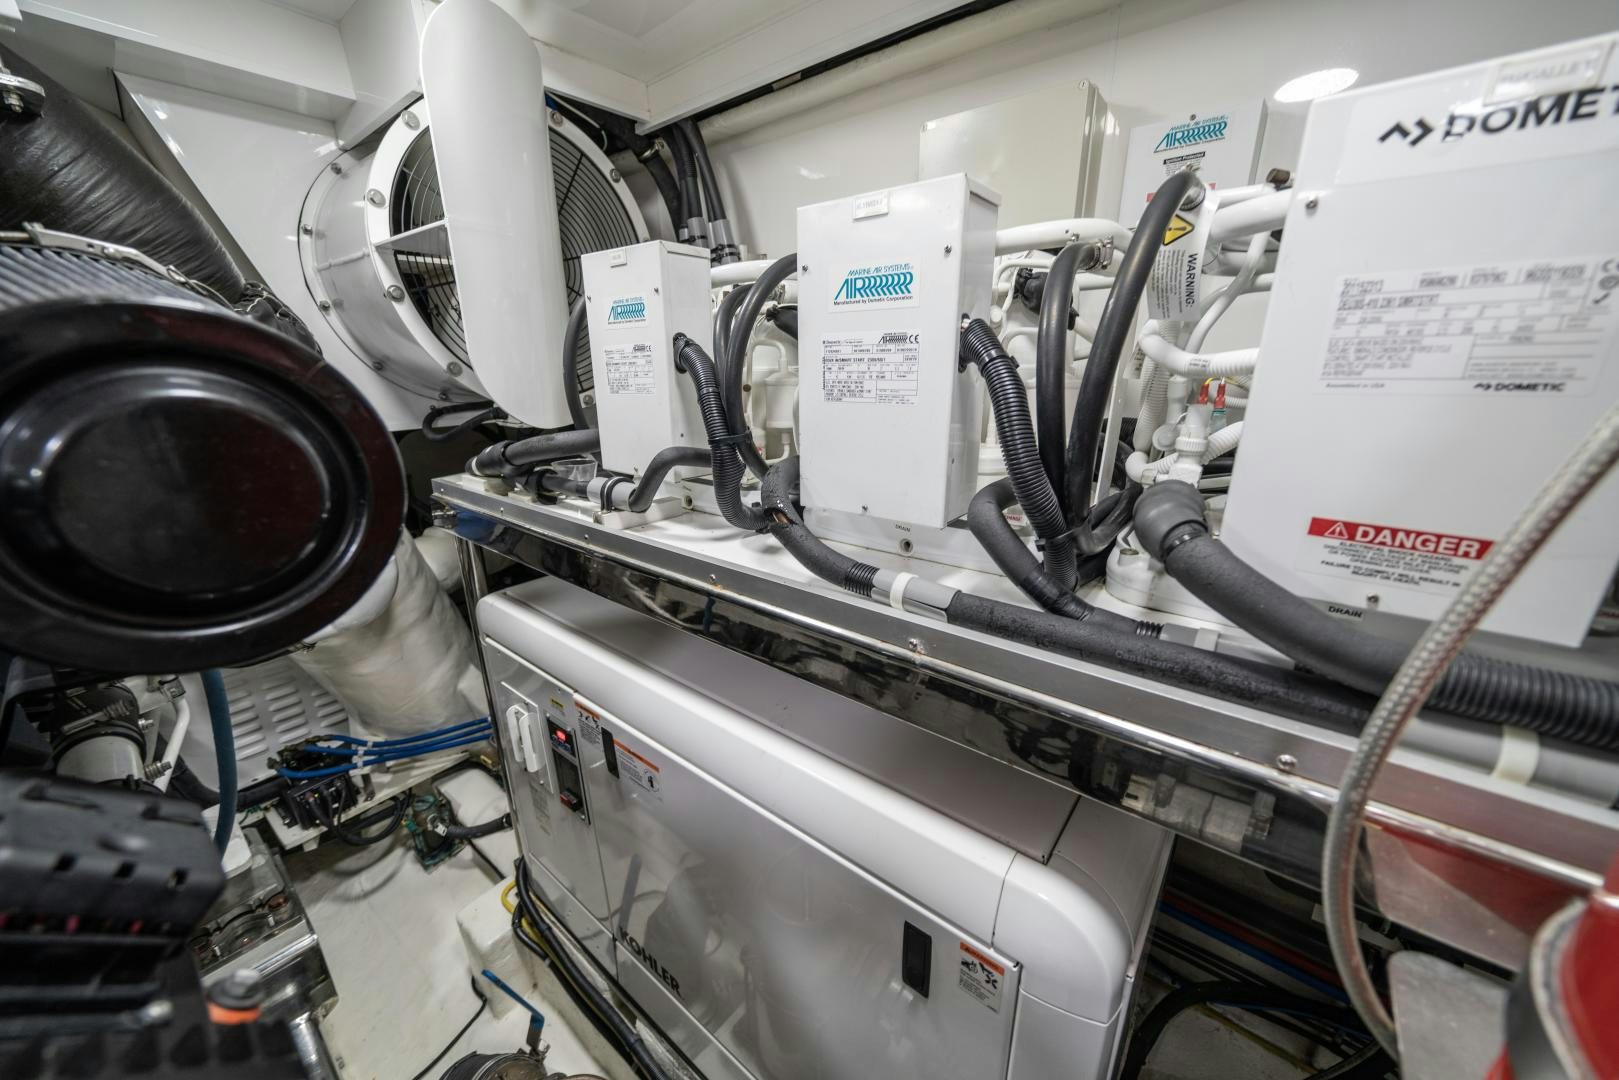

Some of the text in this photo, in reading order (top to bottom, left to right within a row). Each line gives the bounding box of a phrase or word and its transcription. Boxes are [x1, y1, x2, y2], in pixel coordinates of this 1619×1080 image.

[848, 263, 910, 276] MARINE AIR SYSTEMS
[1185, 253, 1198, 307] WARNING:
[1494, 382, 1566, 392] DOMETIC
[1354, 525, 1481, 558] DANGER
[1328, 605, 1362, 618] DRAIN
[619, 925, 682, 998] KOHLER
